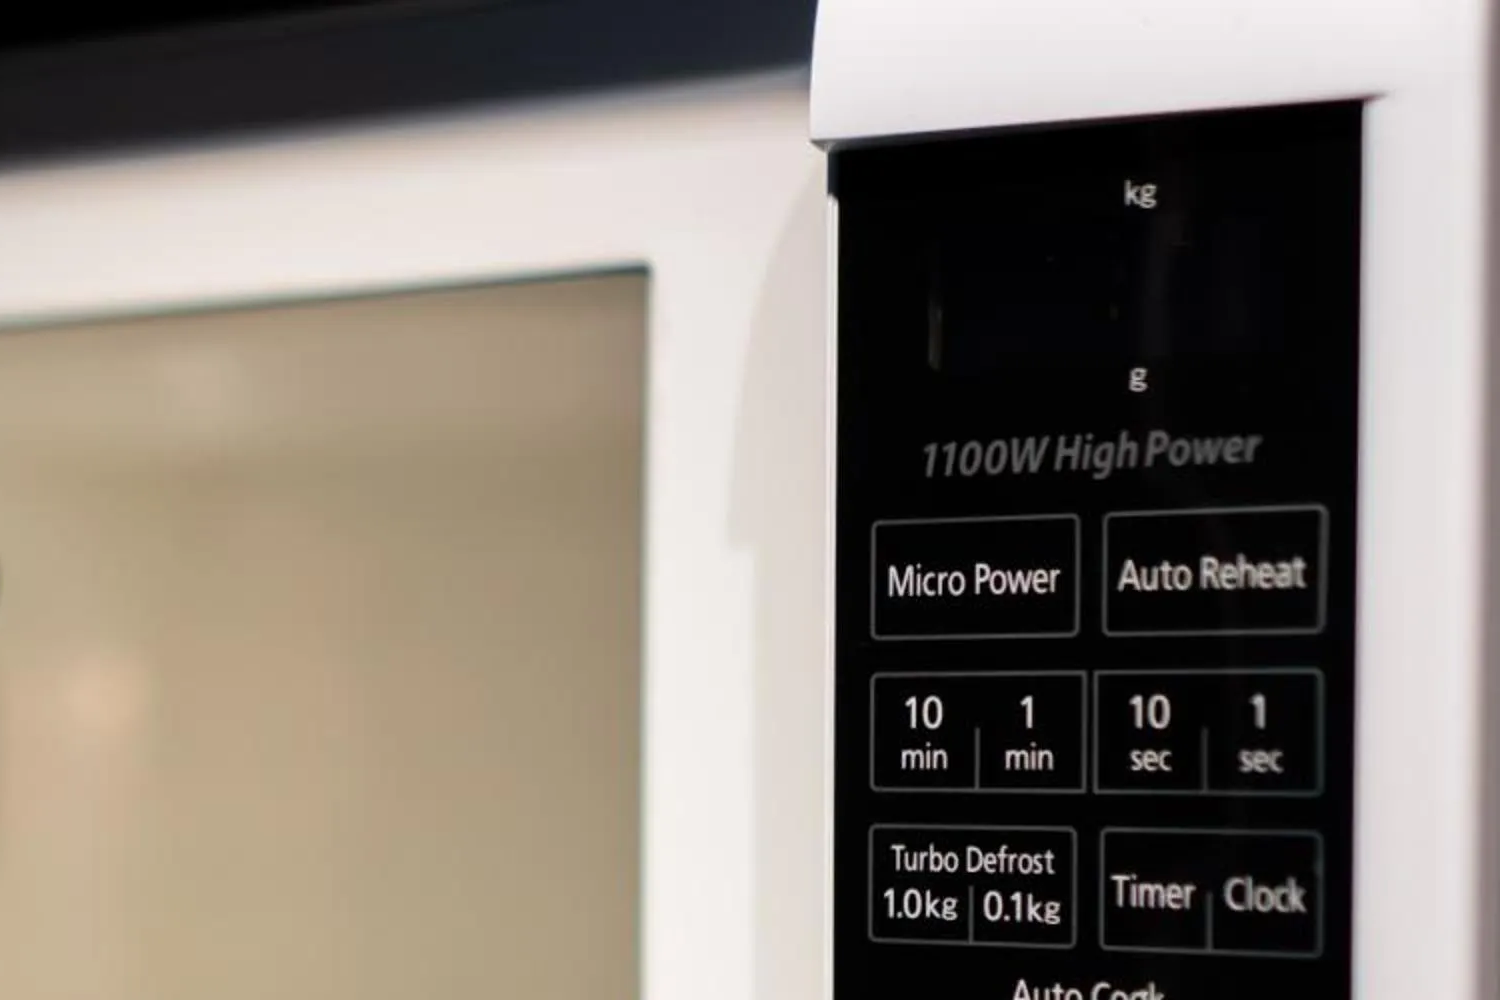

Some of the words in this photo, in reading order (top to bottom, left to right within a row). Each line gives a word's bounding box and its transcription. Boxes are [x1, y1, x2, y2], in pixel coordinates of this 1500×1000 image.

[1124, 180, 1157, 209] kg
[1129, 367, 1148, 393] g
[923, 435, 1050, 478] 1100W
[1054, 430, 1139, 480] High
[1144, 429, 1262, 467] Power
[888, 563, 966, 597] Micro
[974, 562, 1061, 595] Power
[1117, 559, 1193, 591] Auto
[1200, 554, 1306, 590] Reheat
[905, 695, 943, 730] 10
[1020, 695, 1033, 729] 1
[1129, 694, 1171, 730] 10
[1251, 693, 1266, 729] 1
[901, 741, 948, 770] min
[1005, 742, 1054, 770] min
[1130, 749, 1172, 772] sec
[1239, 750, 1283, 773] sec
[890, 843, 959, 873] Turbo
[966, 844, 1055, 875] Defrost
[883, 887, 958, 921] 1.0kg
[983, 890, 1061, 925] 0.1kg
[1111, 874, 1196, 910] Timer
[1224, 876, 1306, 913] Clock
